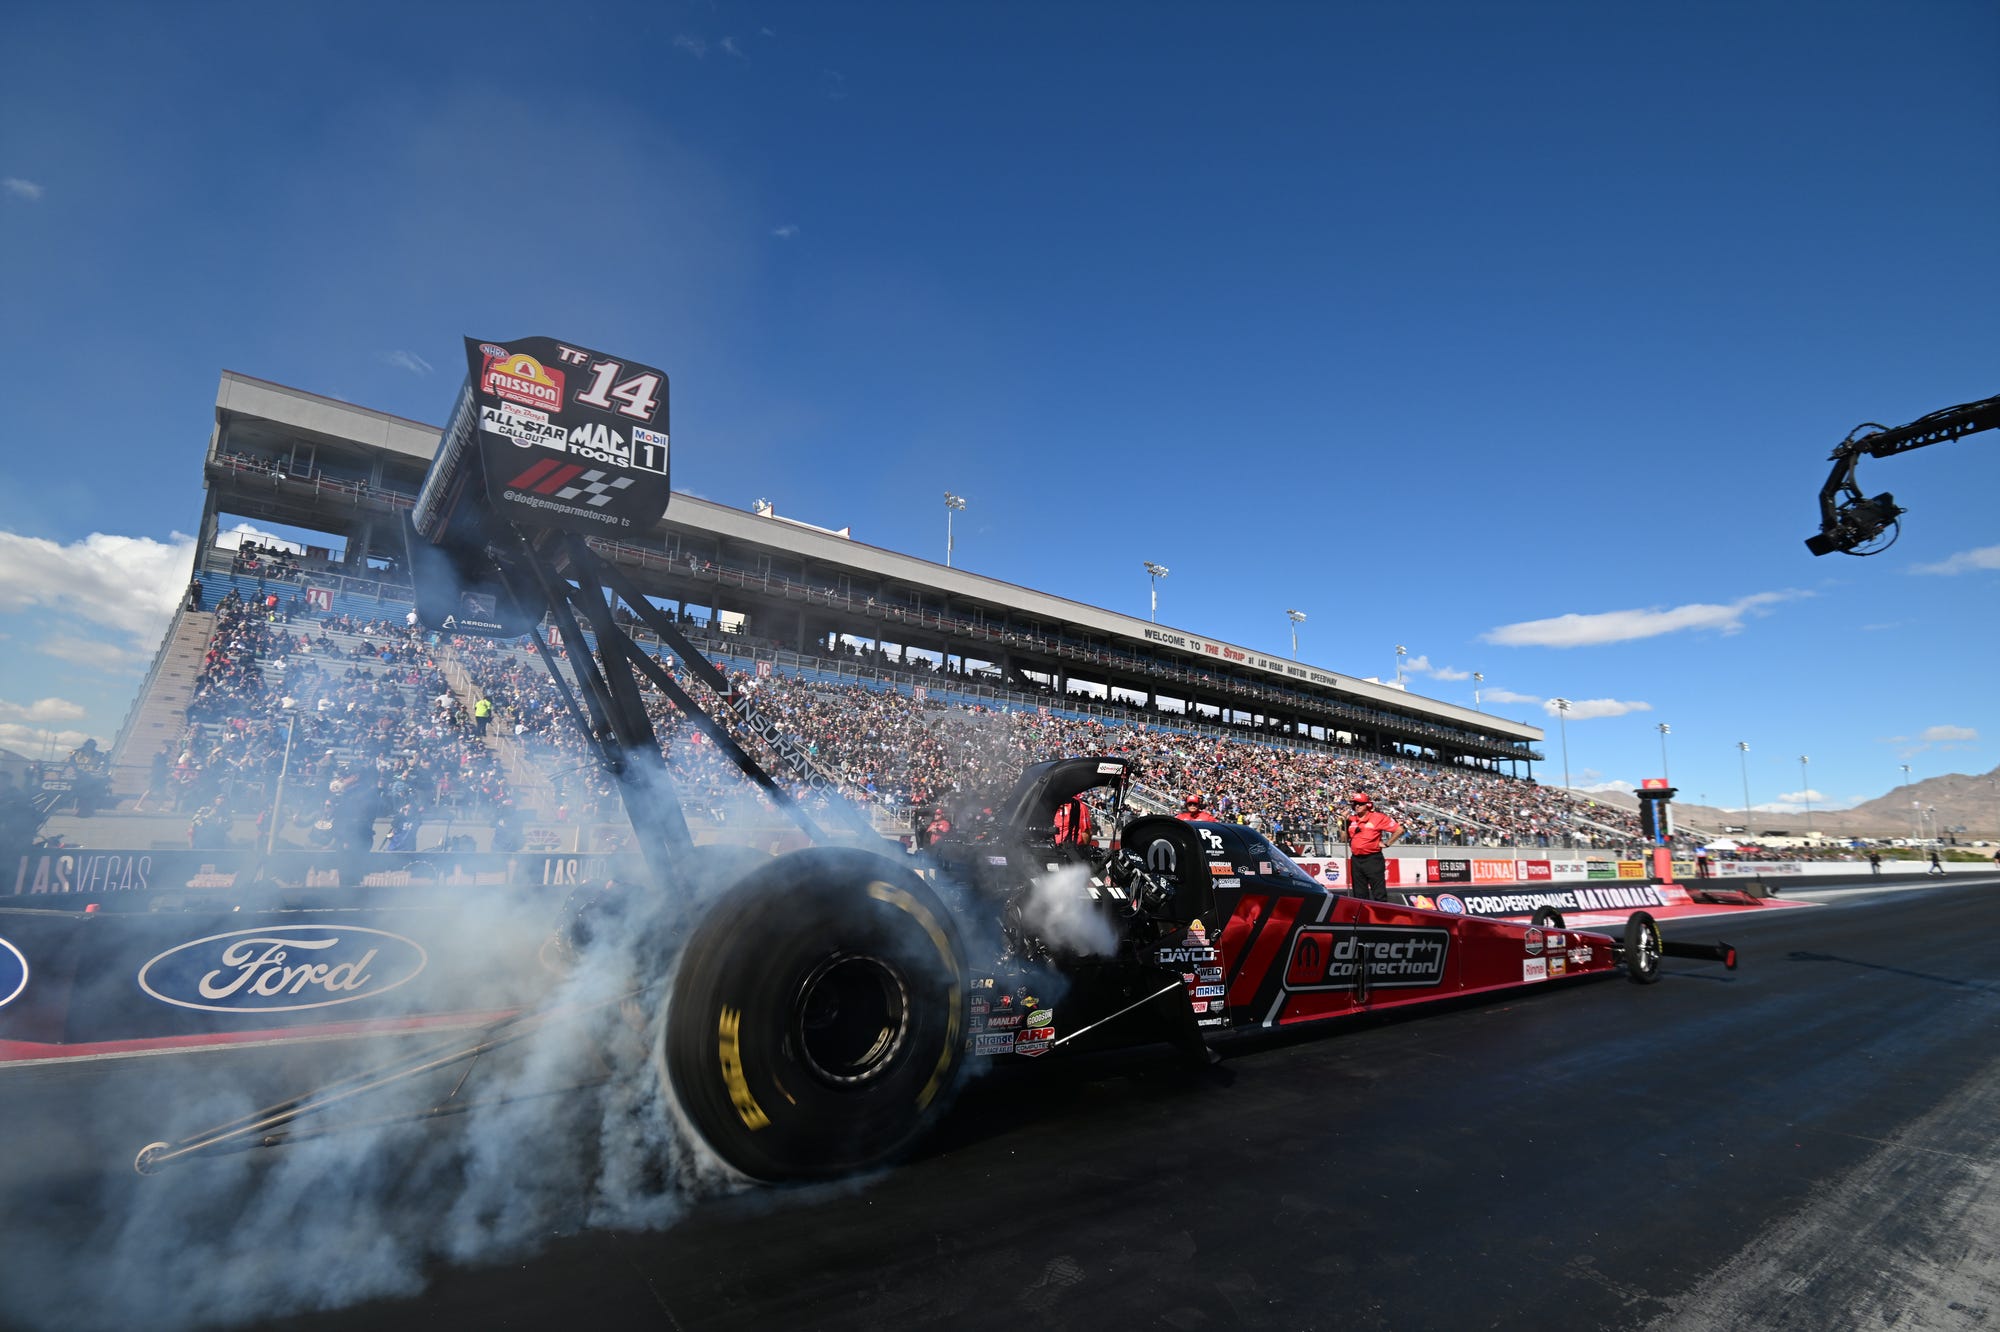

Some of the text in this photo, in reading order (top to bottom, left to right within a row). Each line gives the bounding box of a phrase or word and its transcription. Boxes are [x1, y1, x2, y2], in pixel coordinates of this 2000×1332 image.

[484, 346, 506, 358] NHRA
[559, 346, 588, 365] TF
[578, 362, 659, 421] 14
[498, 426, 545, 443] CALLOUT
[568, 423, 630, 459] MAC
[634, 429, 667, 446] Mobil
[568, 443, 630, 468] TOOLS
[643, 445, 655, 468] 1
[1144, 628, 1185, 647] WELCOME
[1189, 640, 1201, 651] TO
[1204, 643, 1220, 656] THE
[1258, 659, 1267, 668] LAS
[1268, 661, 1284, 673] VEGAS
[1287, 666, 1307, 679] MOTOR
[1310, 672, 1338, 686] SPEEDWAY
[732, 697, 836, 801] INSURANCE
[1474, 862, 1514, 879] LiUNA!
[1528, 865, 1549, 875] TOYOTA
[1573, 887, 1660, 911] NATIONALS
[1159, 947, 1217, 963] DAYCO
[199, 938, 378, 999] Ford
[1200, 967, 1222, 977] WELD
[1196, 986, 1224, 997] MAHLE
[987, 1015, 1020, 1027] MANLEY
[1027, 1010, 1052, 1026] GOODSON
[977, 1034, 1013, 1045] Strange
[1016, 1027, 1054, 1043] ARP
